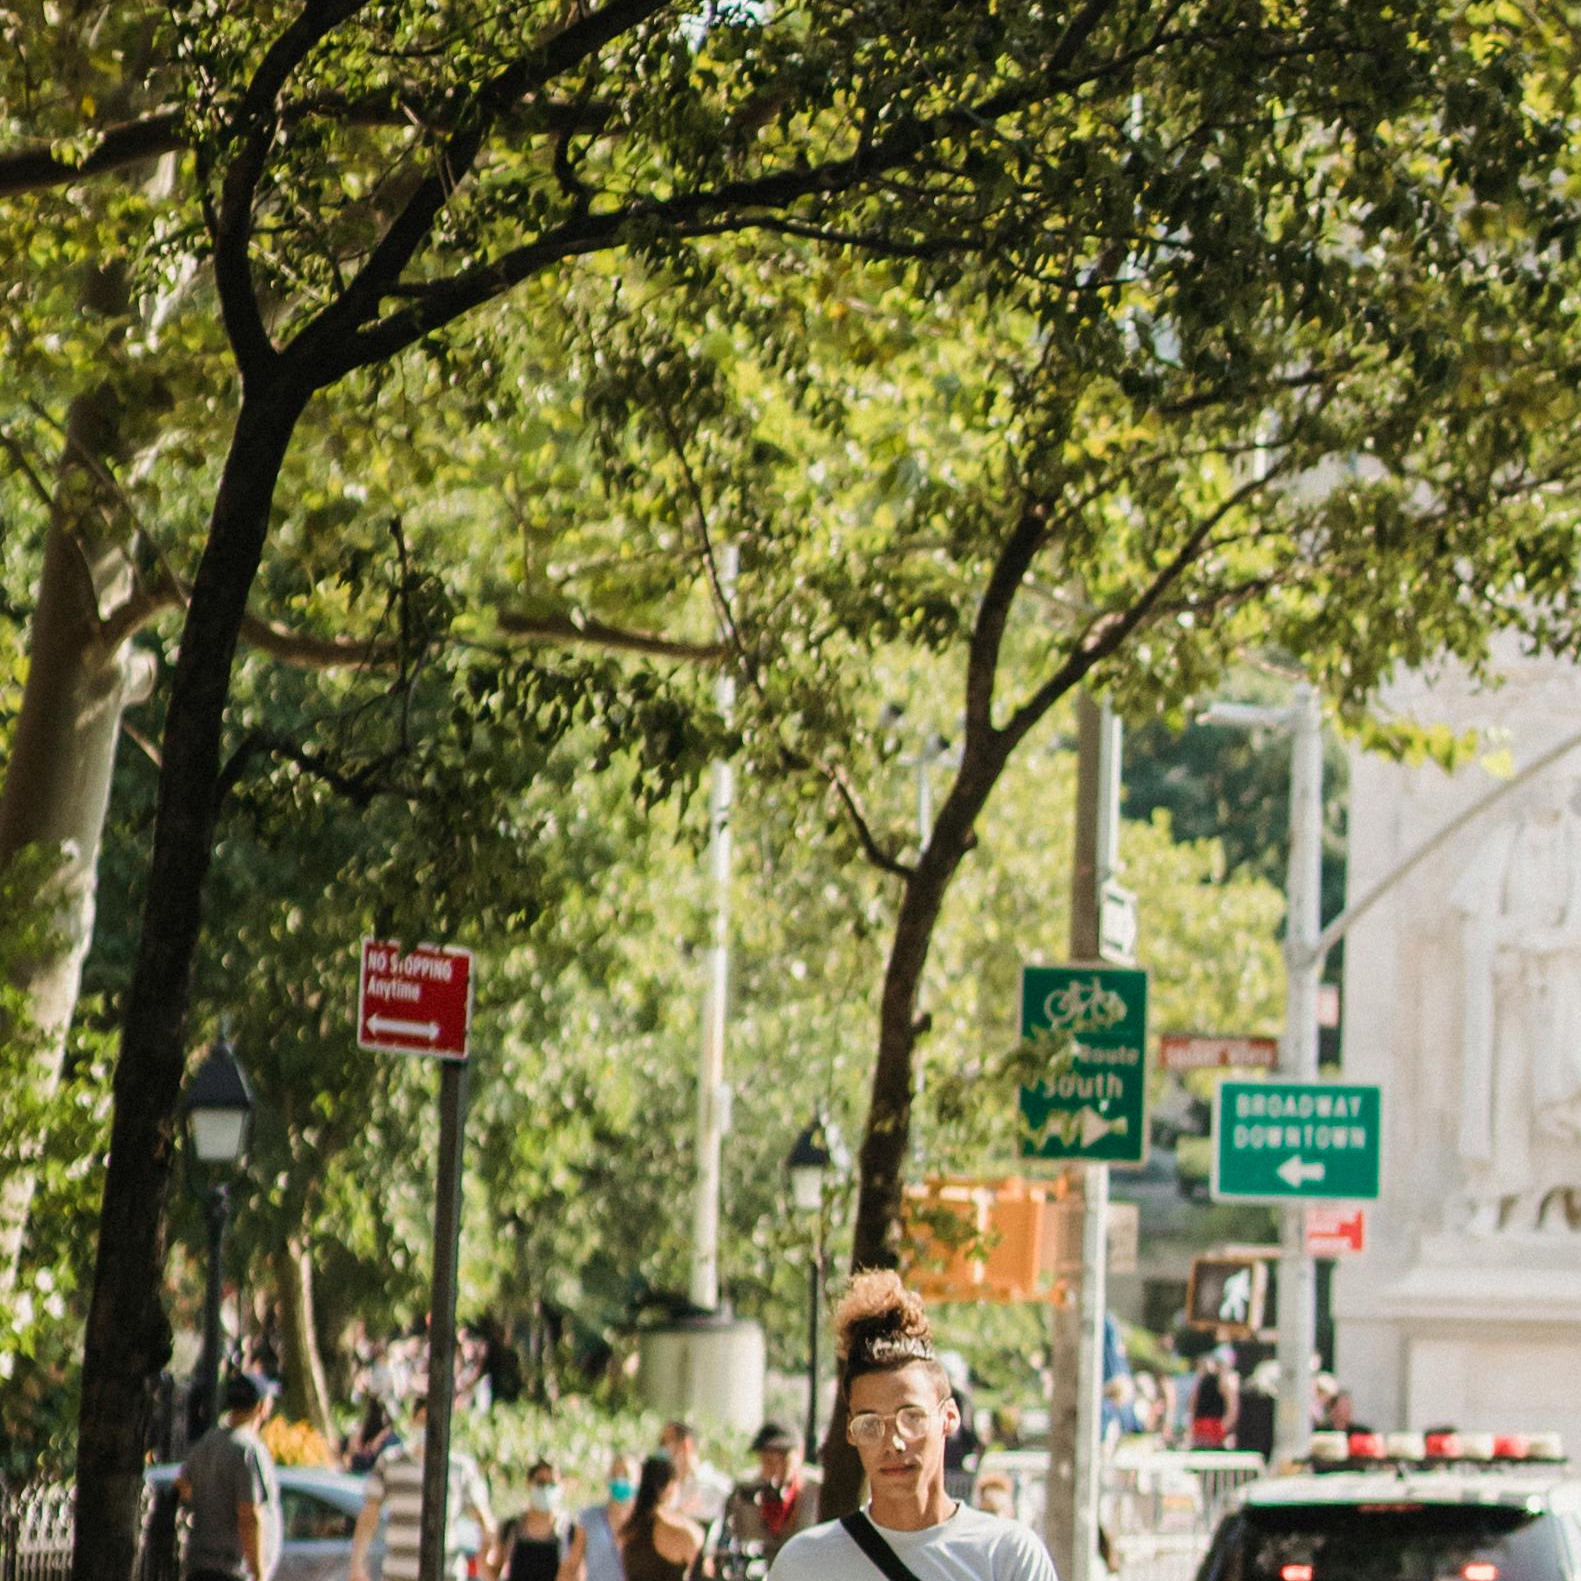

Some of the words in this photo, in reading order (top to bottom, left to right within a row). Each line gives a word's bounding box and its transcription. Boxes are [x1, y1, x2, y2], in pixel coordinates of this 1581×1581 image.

[368, 950, 387, 974] NO
[367, 975, 421, 1003] Anytime
[1236, 1094, 1362, 1118] BROADWAY
[1233, 1124, 1367, 1150] DOWNTOWN
